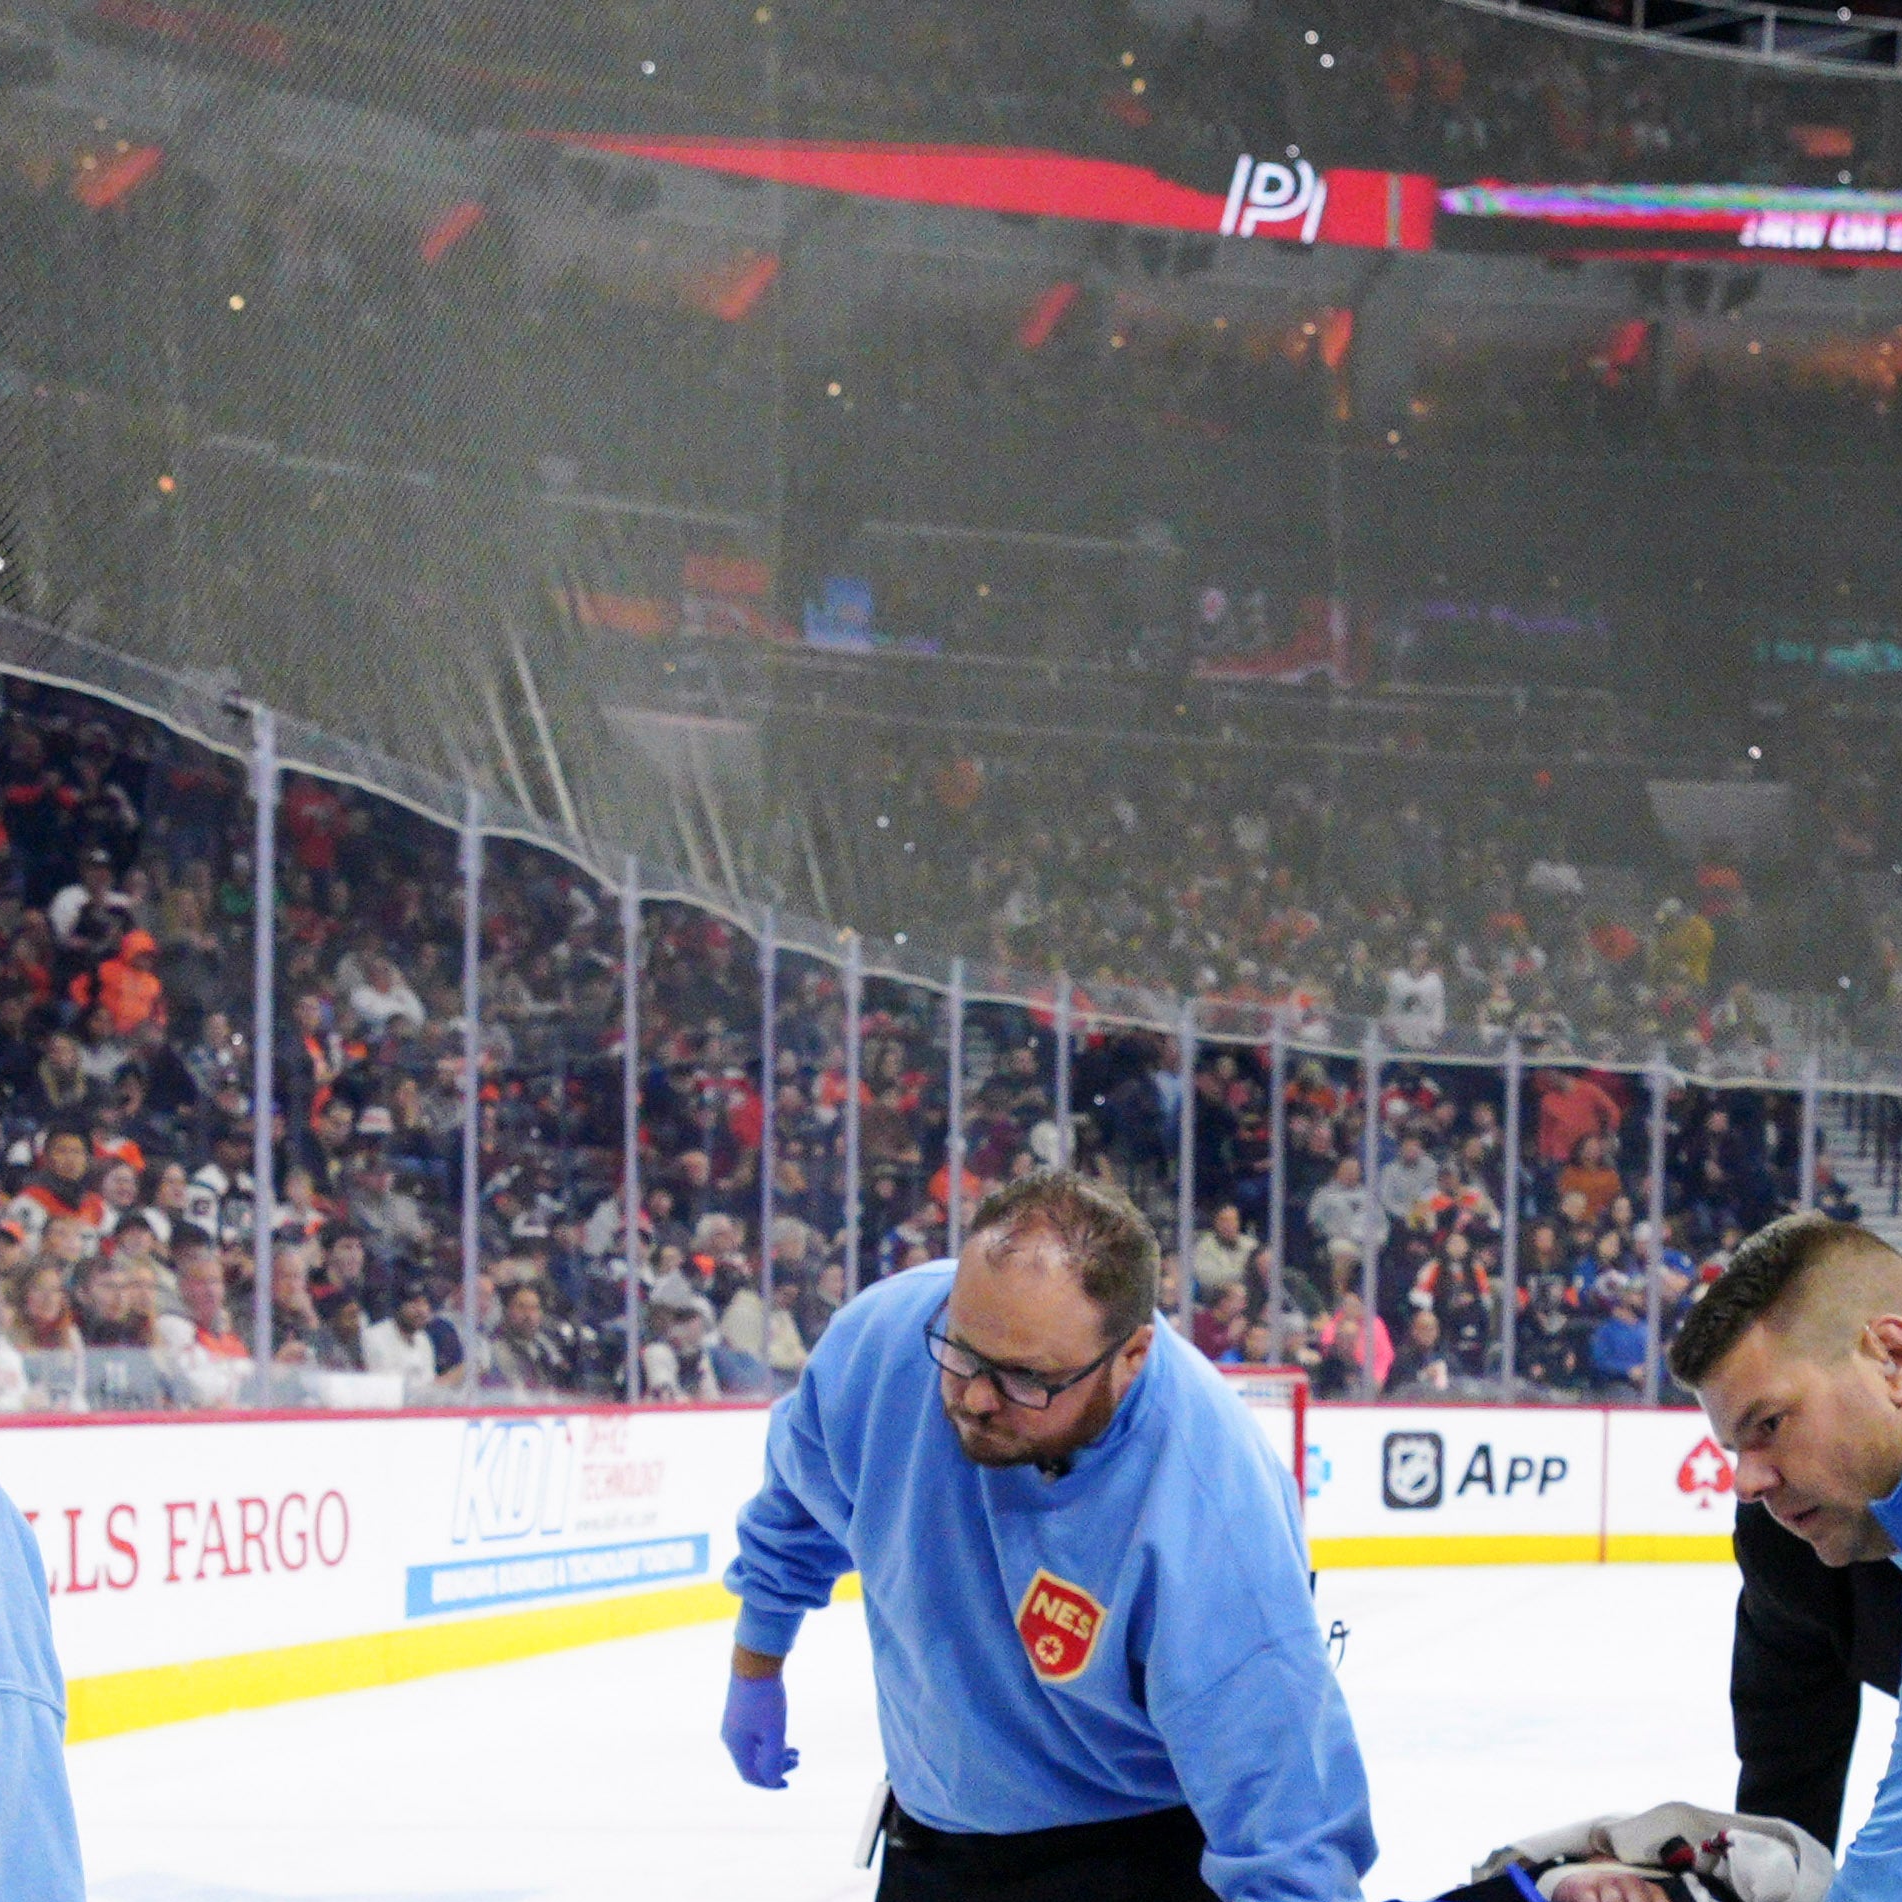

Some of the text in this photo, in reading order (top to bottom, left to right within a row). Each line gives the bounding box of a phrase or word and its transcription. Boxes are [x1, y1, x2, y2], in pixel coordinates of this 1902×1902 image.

[451, 1419, 574, 1545] KDI
[163, 1488, 350, 1584] FARGO
[1032, 1590, 1094, 1641] NES
